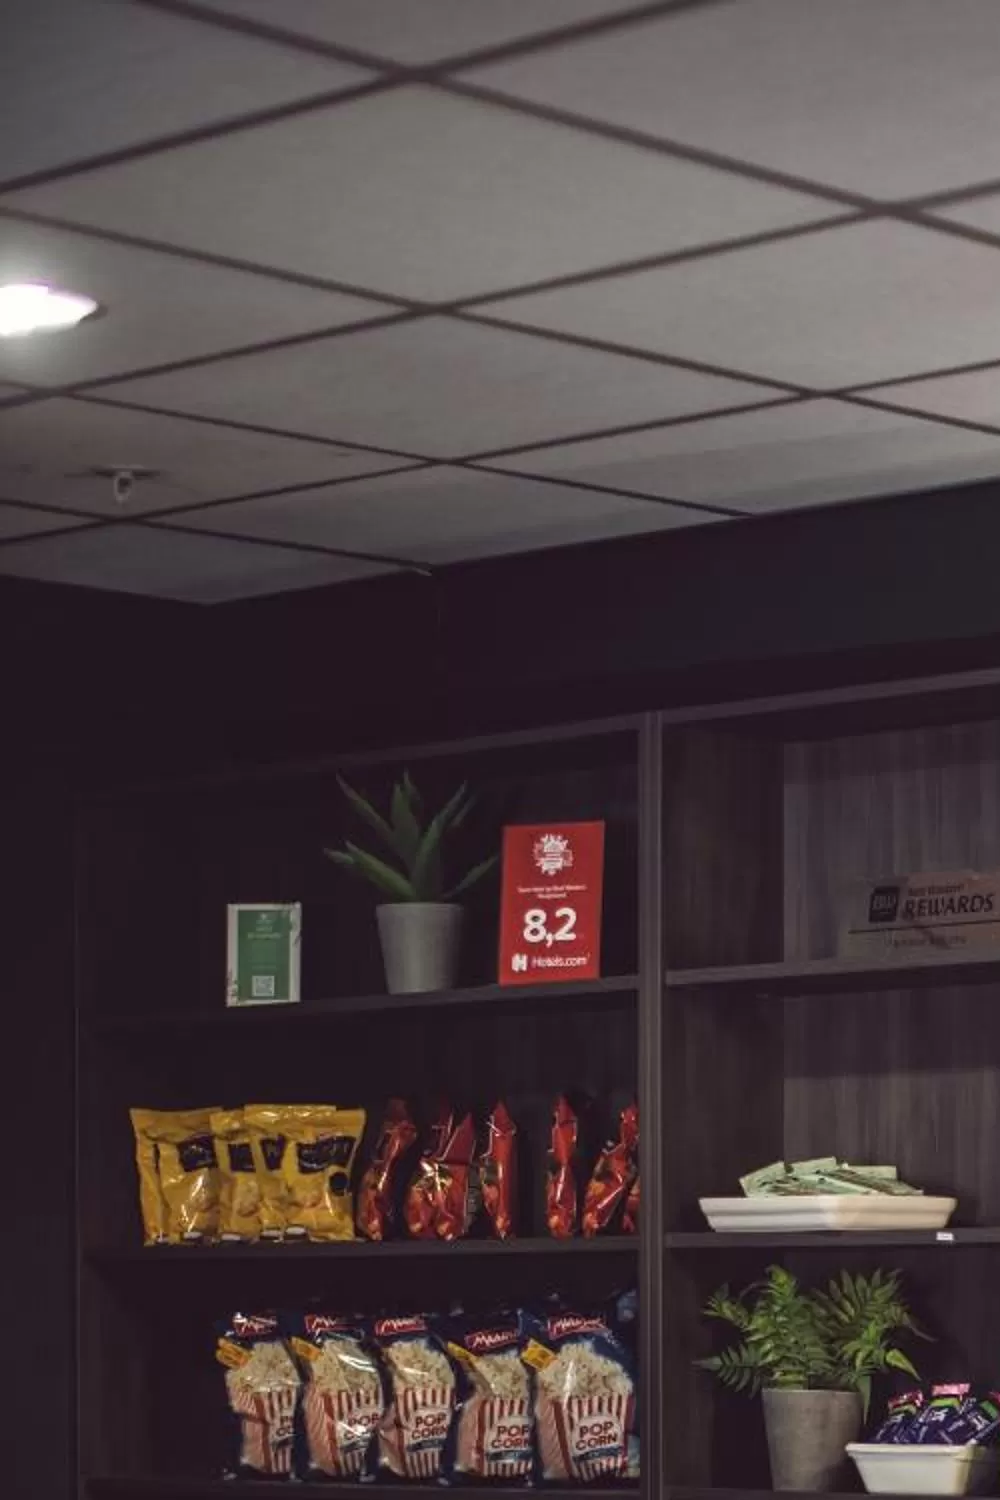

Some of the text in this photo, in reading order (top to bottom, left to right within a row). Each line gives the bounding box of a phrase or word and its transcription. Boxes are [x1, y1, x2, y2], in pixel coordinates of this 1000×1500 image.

[903, 893, 996, 920] REWARDS
[523, 907, 577, 947] 8,2
[415, 1413, 447, 1427] POP
[579, 1420, 615, 1438] POP
[576, 1433, 618, 1450] CORN
